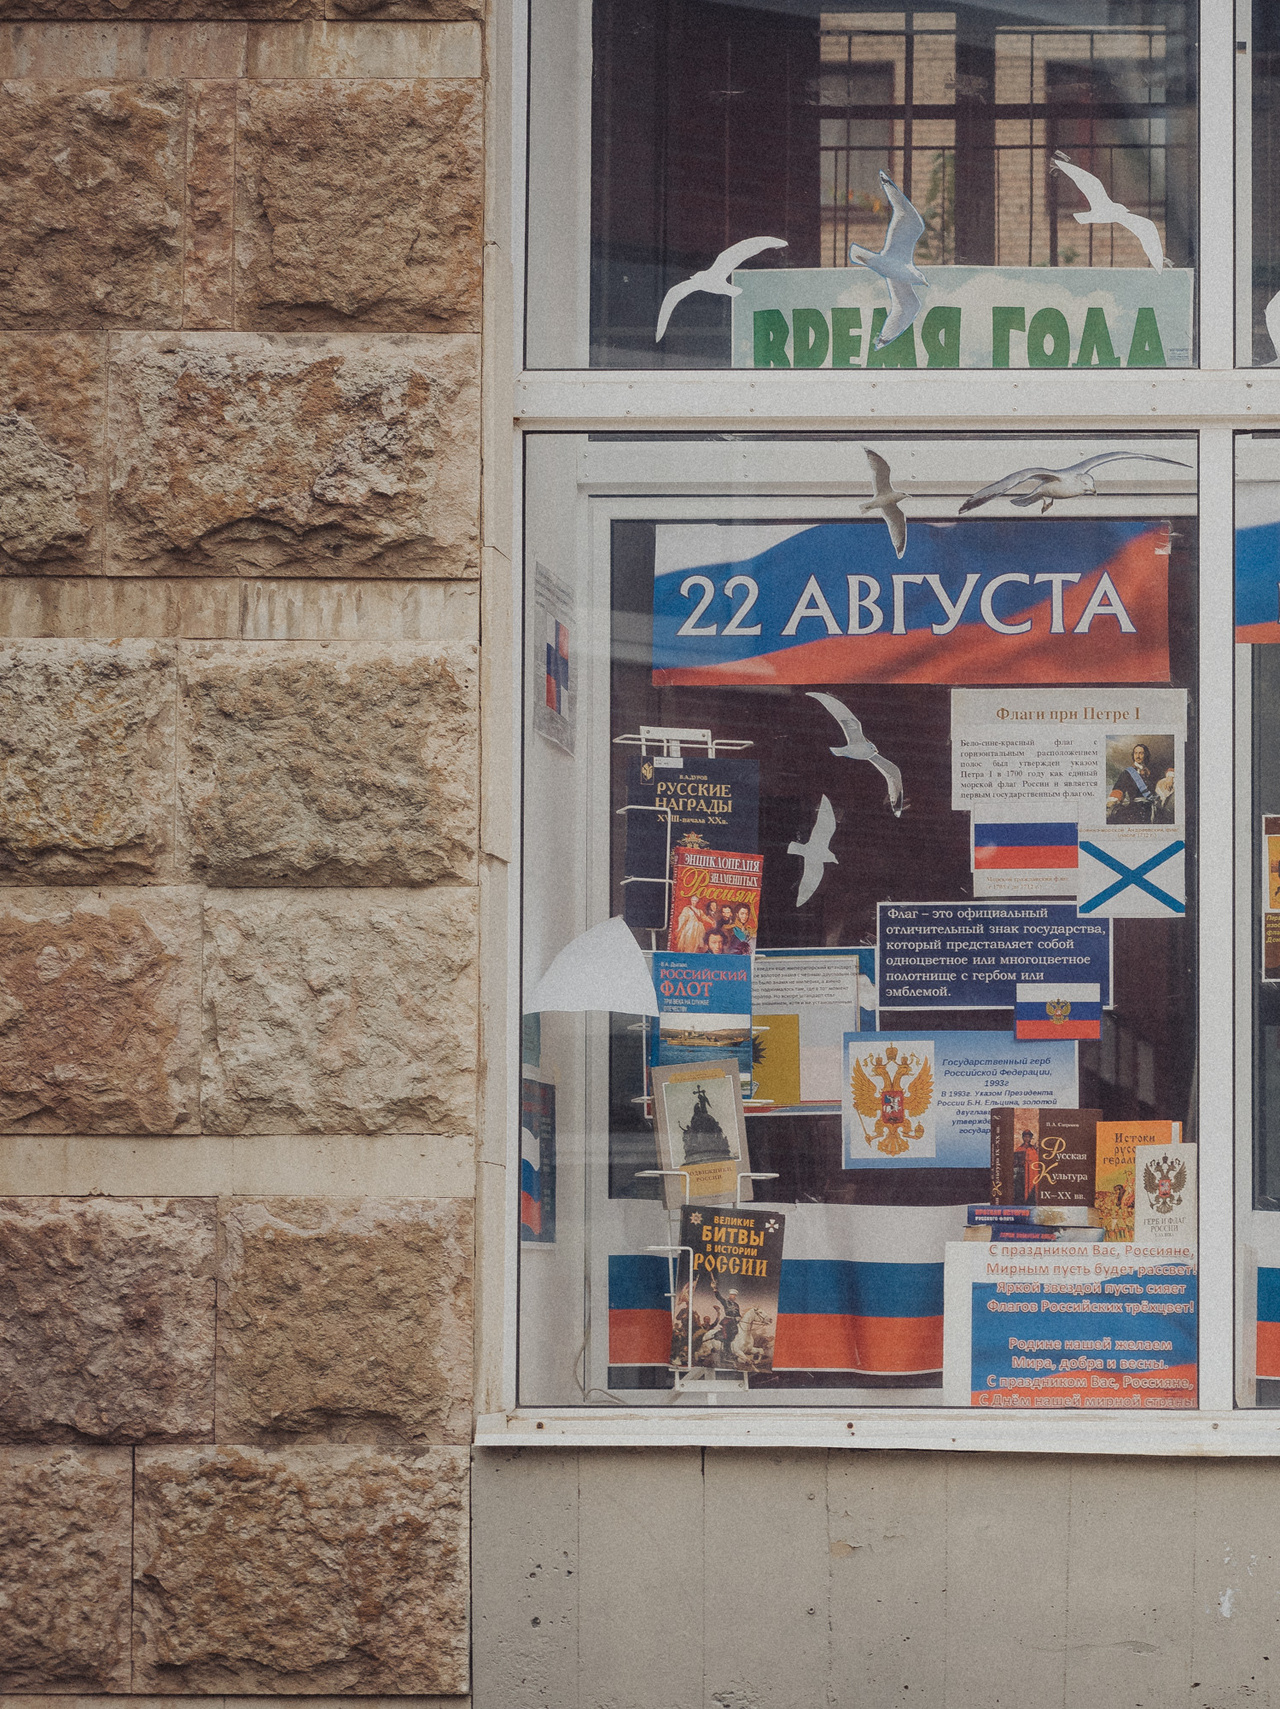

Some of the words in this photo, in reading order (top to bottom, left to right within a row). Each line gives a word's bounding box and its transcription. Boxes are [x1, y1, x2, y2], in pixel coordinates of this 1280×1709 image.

[677, 575, 762, 636] 22
[781, 572, 1136, 635] АВГУСТА
[996, 707, 1045, 721] Флаги
[1050, 711, 1078, 722] при
[1083, 707, 1130, 723] Петре
[1054, 739, 1074, 747] флаг
[961, 771, 984, 779] Петра
[1028, 771, 1045, 779] году
[657, 782, 731, 797] РУССКИЕ
[961, 781, 992, 789] морской
[997, 781, 1016, 789] флаг
[992, 790, 1061, 799] государственным
[655, 797, 732, 814] НАГРАДЫ
[685, 854, 760, 872] ЭНЦИКЛОПЕДИЯ
[681, 867, 758, 904] Россиян
[710, 873, 758, 887] ЗНАМЕНИТЫХ
[888, 909, 918, 919] Флаг
[958, 908, 1048, 922] официальный
[886, 924, 984, 934] отличительный
[1023, 926, 1106, 935] государства,
[886, 939, 941, 952] который
[946, 941, 1033, 952] представляет
[1038, 939, 1074, 949] собой
[886, 956, 968, 966] одноцветное
[973, 956, 995, 964] или
[1000, 956, 1090, 966] многоцветное
[661, 969, 747, 981] РОССИЙСКИЙ
[886, 972, 956, 983] полотнище
[961, 972, 968, 980] с
[973, 970, 1016, 982] гербом
[1021, 972, 1044, 980] или
[660, 980, 713, 996] ФЛОТ
[886, 986, 951, 997] эмблемой.
[942, 1058, 1028, 1068] Государственный
[1030, 1058, 1051, 1066] герб
[944, 1068, 997, 1078] Российской
[1000, 1069, 1052, 1078] Федерации,
[1005, 1089, 1053, 1097] Президента
[1115, 1133, 1155, 1143] Истоки
[1041, 1137, 1087, 1161] Русская
[1031, 1162, 1088, 1185] Культура
[714, 1216, 755, 1228] ВЕЛИКИЕ
[702, 1226, 765, 1246] БИТВЫ
[706, 1244, 712, 1252] В
[714, 1244, 758, 1256] ИСТОРИИ
[989, 1245, 996, 1256] С
[1004, 1245, 1088, 1257] праздником
[1093, 1245, 1121, 1257] Вас,
[1125, 1245, 1195, 1258] Россияне,
[693, 1253, 768, 1277] РОССИИ
[986, 1263, 1049, 1275] Мирным
[1053, 1265, 1090, 1276] пусть
[1095, 1263, 1134, 1277] будет
[1137, 1264, 1197, 1277] рассвет!
[996, 1281, 1041, 1295] Яркой
[1043, 1282, 1101, 1295] звездой
[1105, 1284, 1144, 1296] пусть
[1146, 1284, 1187, 1294] сияет
[987, 1300, 1038, 1313] Флагов
[1041, 1300, 1122, 1313] Российских
[1125, 1300, 1194, 1315] трёхцвет!
[1008, 1337, 1061, 1352] Родине
[1064, 1337, 1112, 1350] нашей
[1114, 1339, 1173, 1350] желаем
[1012, 1356, 1057, 1371] Мира,
[1059, 1356, 1103, 1371] добра
[1107, 1359, 1117, 1369] и
[1120, 1358, 1169, 1370] весны.
[987, 1375, 997, 1387] С
[999, 1376, 1087, 1389] праздником
[1091, 1375, 1120, 1390] Вас,
[1123, 1375, 1194, 1390] Россияне,
[978, 1394, 989, 1406] С
[991, 1394, 1031, 1408] Днём
[1035, 1394, 1082, 1407] нашей
[1084, 1393, 1142, 1408] мирной
[1144, 1397, 1195, 1408] страны
